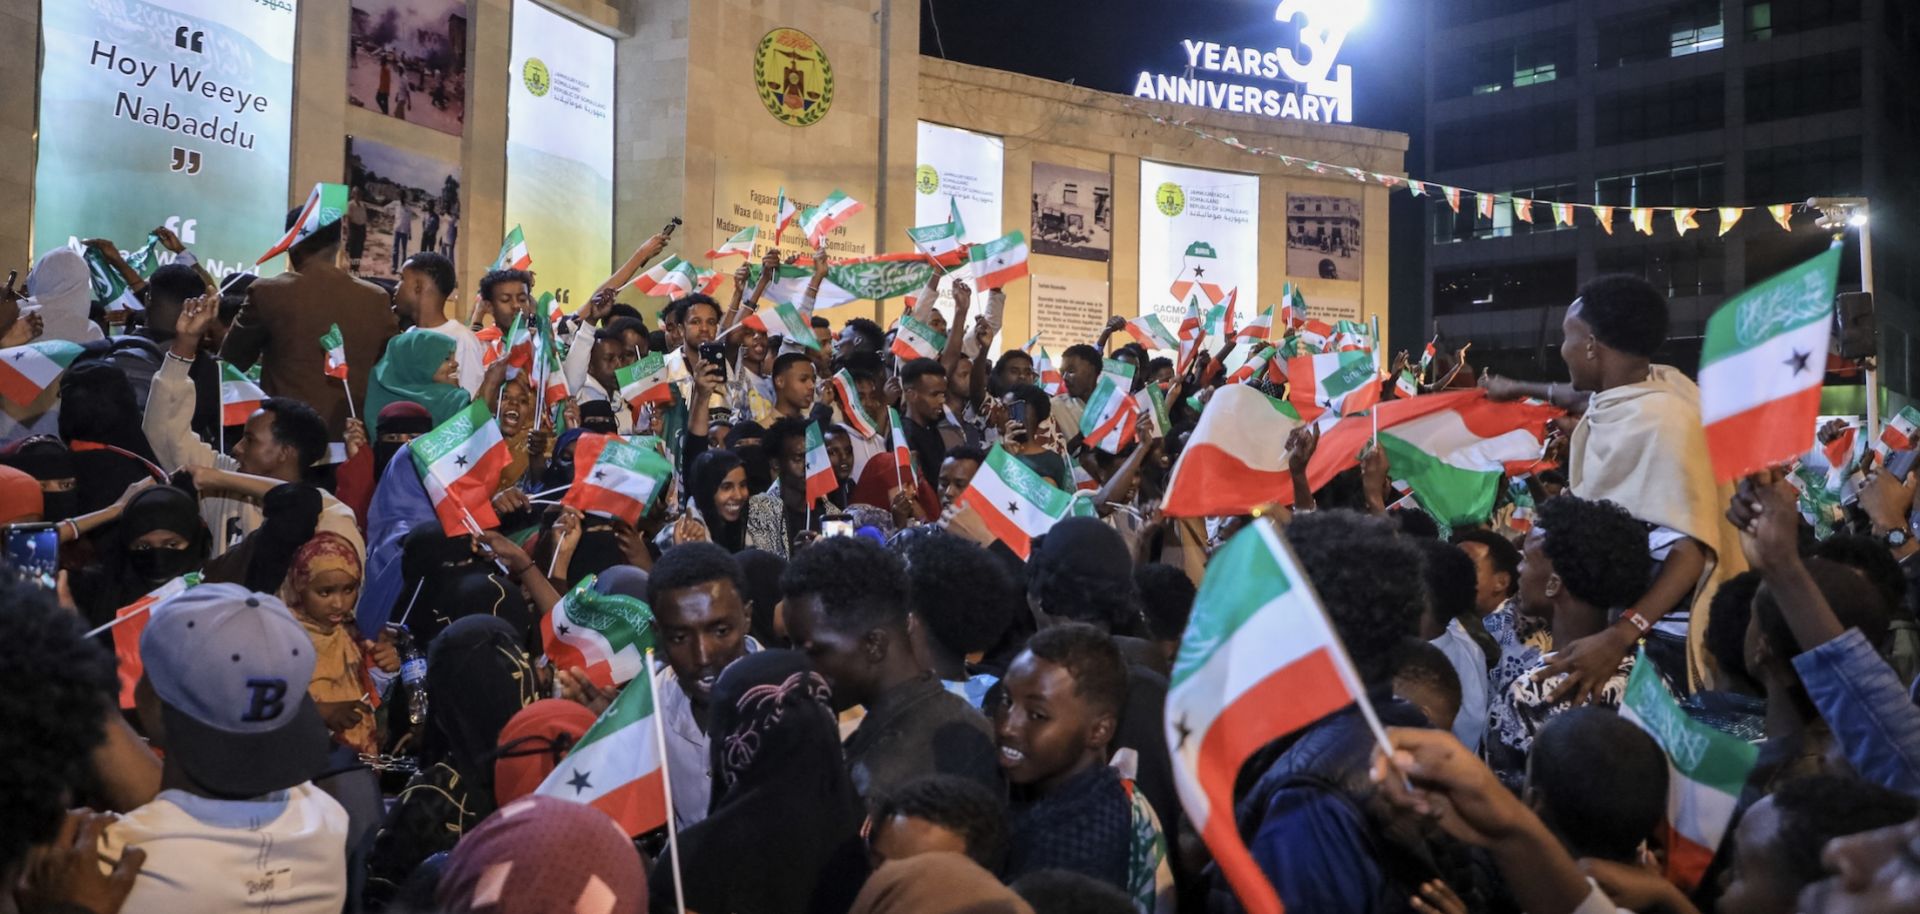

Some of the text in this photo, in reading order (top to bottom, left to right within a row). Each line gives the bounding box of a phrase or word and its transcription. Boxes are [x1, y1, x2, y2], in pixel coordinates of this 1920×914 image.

[90, 40, 268, 113] Hoy Weeye
[1183, 39, 1279, 79] YEARS
[1134, 71, 1339, 123] ANNIVERSARY
[115, 91, 255, 149] Nabaddu
[734, 204, 751, 218] Waxa
[753, 209, 764, 221] dib
[825, 239, 866, 254] Somaliland
[242, 678, 288, 722] B
